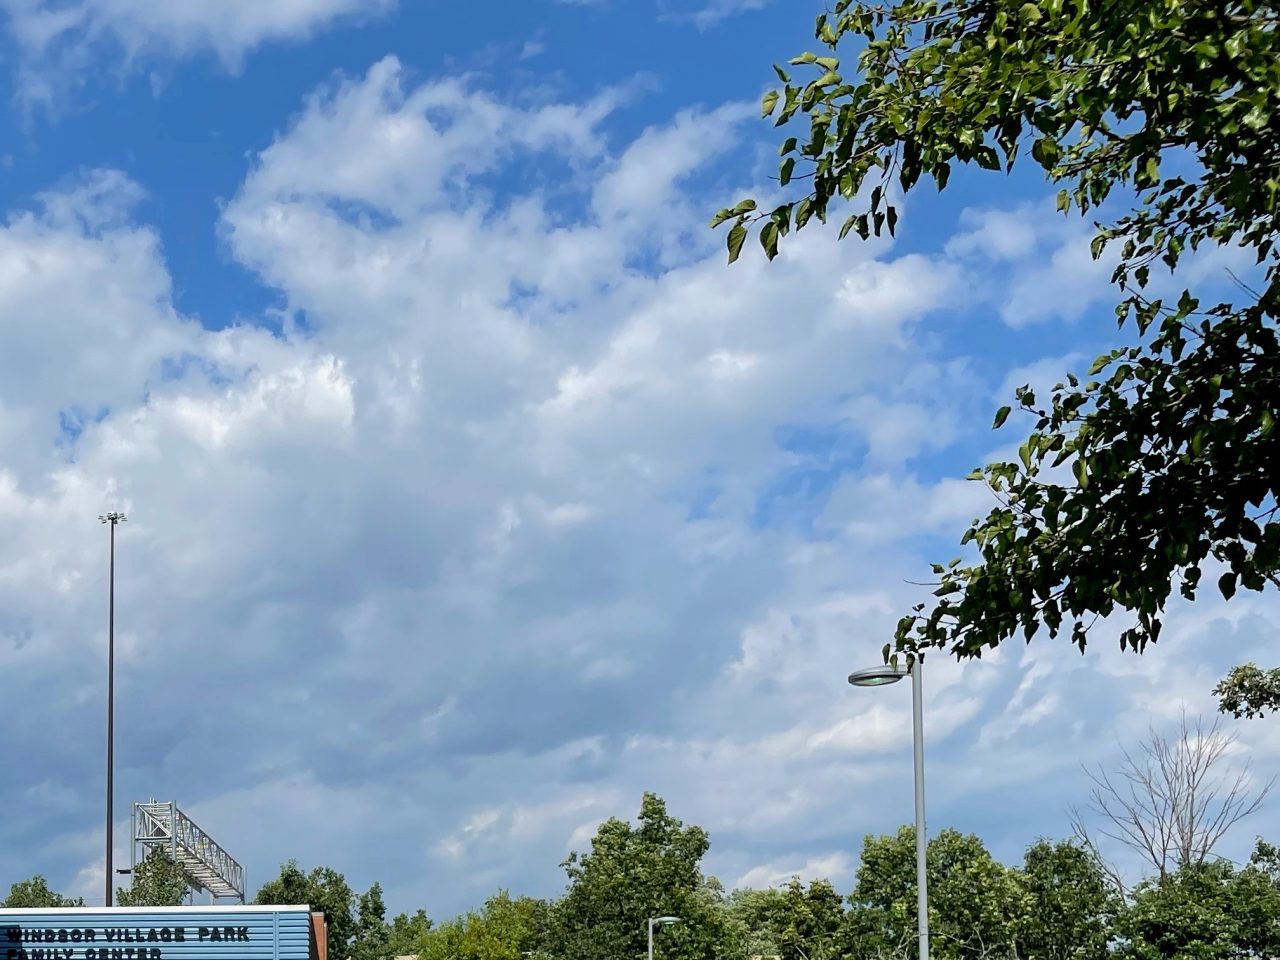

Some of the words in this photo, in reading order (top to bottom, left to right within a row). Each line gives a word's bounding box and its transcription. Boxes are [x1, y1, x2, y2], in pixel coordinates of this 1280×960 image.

[7, 928, 96, 943] WINDSOR
[104, 927, 185, 943] VILLAGE
[199, 926, 249, 942] PARK
